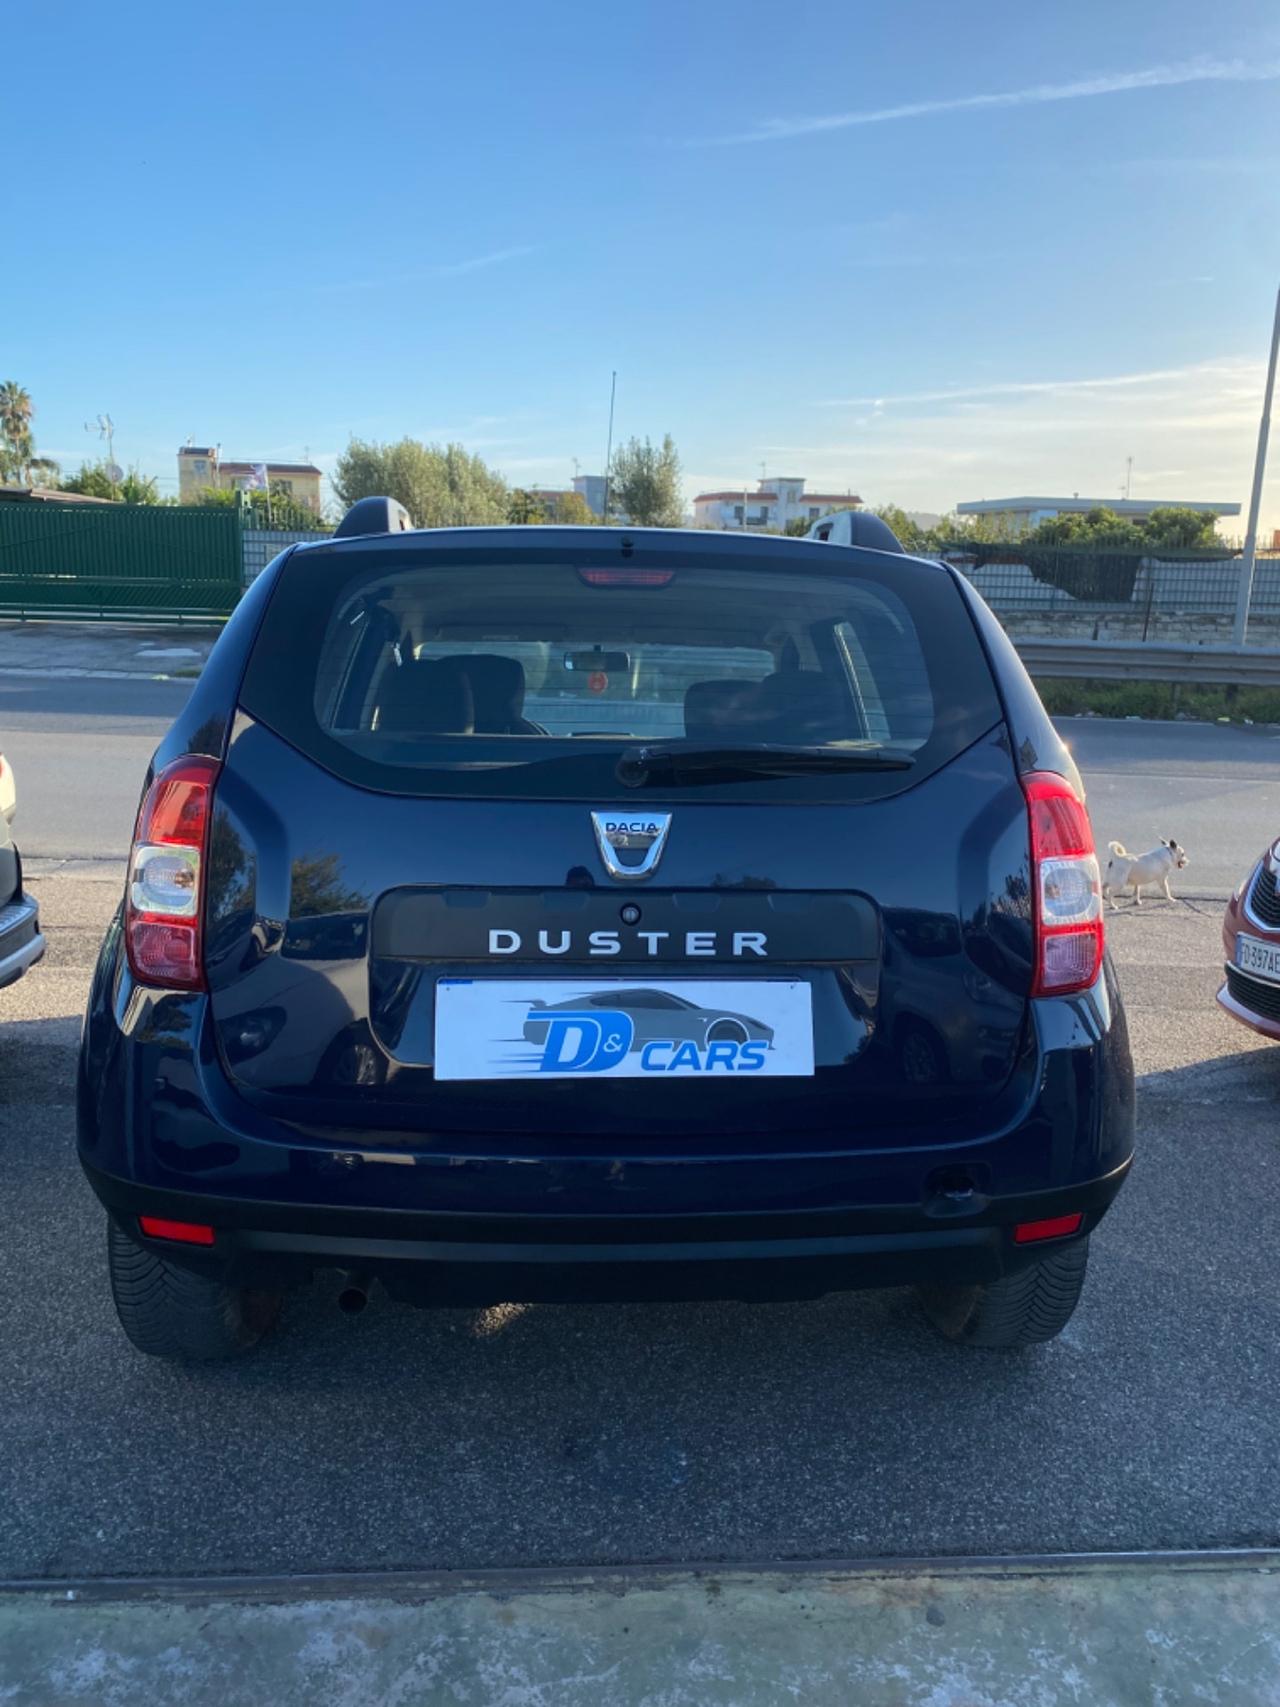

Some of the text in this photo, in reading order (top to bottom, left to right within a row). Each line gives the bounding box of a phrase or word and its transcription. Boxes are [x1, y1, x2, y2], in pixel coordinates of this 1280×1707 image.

[605, 822, 658, 833] DACIA
[488, 929, 769, 956] DUSTER
[640, 1041, 769, 1072] CARS
